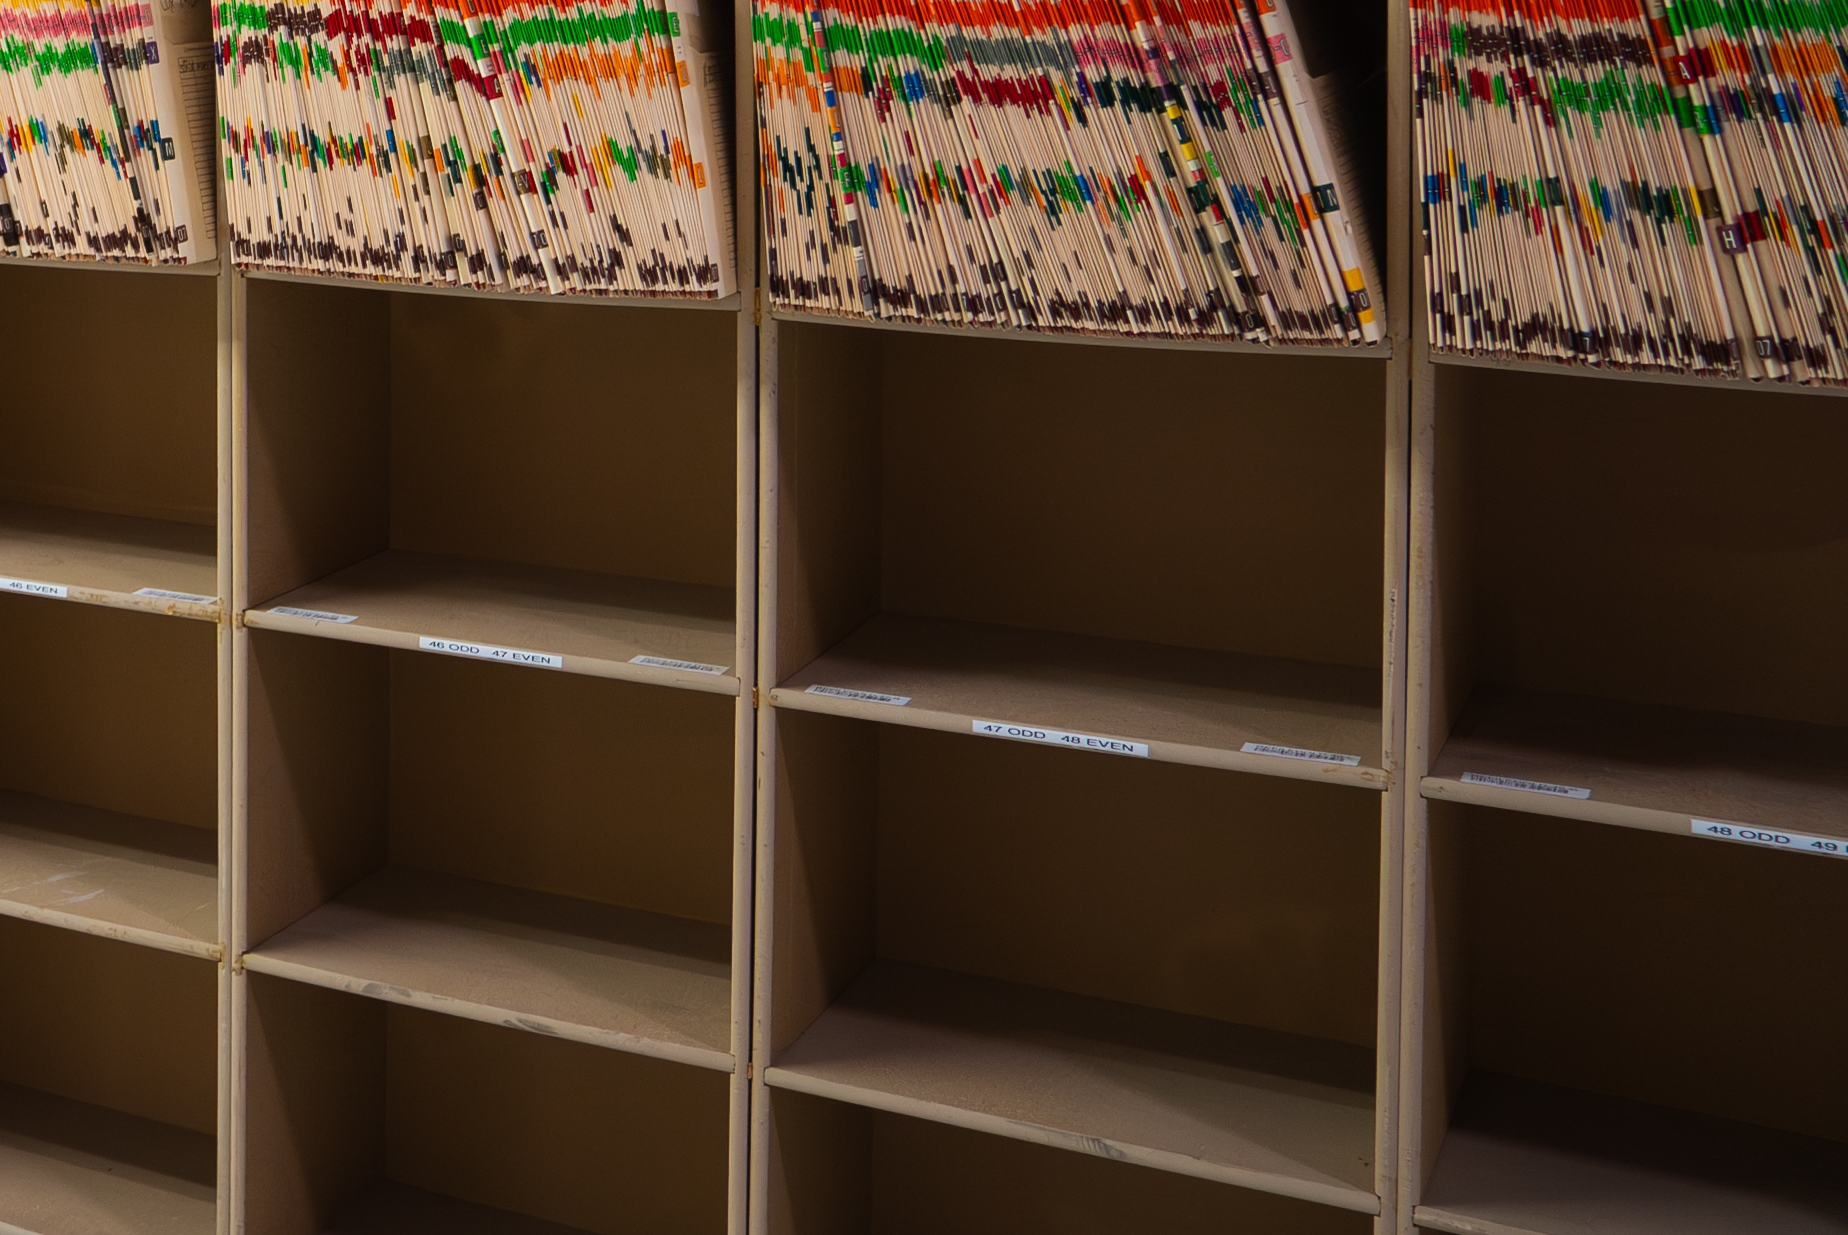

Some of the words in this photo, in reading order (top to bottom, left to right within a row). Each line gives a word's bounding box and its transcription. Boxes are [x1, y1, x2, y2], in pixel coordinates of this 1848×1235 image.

[480, 38, 489, 55] E
[493, 77, 502, 94] A
[149, 45, 157, 61] X
[165, 141, 175, 157] M
[177, 227, 187, 242] 07
[1679, 60, 1692, 80] A
[1723, 227, 1738, 250] H
[1756, 338, 1771, 356] 07
[8, 581, 23, 590] 46
[25, 583, 59, 595] EVEN
[428, 640, 445, 650] 46
[448, 643, 481, 655] ODD
[491, 649, 509, 659] 47
[512, 652, 552, 665] EVEN
[983, 723, 1004, 734] 47
[1007, 726, 1047, 740] ODD
[1060, 734, 1082, 745] 48
[1085, 737, 1135, 753] EVEN
[1706, 824, 1733, 837] 48
[1738, 829, 1791, 845] ODD
[1809, 840, 1839, 853] 49
